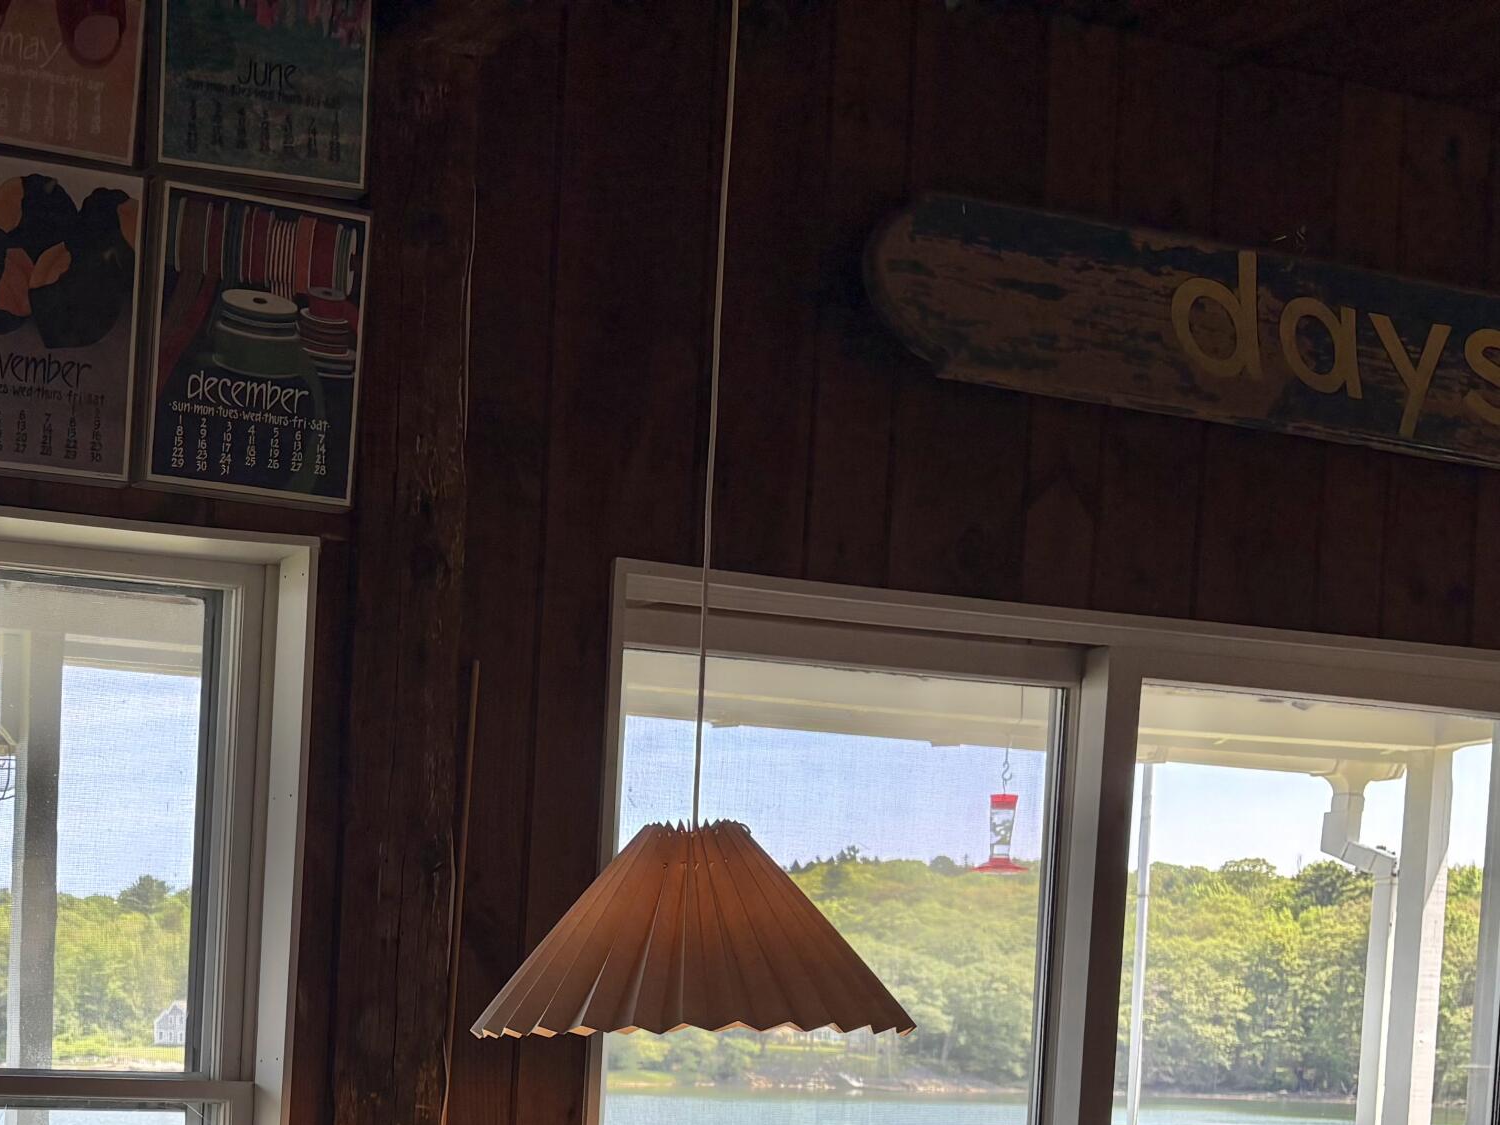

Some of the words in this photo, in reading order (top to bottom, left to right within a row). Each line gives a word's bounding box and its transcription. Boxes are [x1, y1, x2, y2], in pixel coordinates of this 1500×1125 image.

[0, 32, 62, 68] may
[188, 370, 309, 414] december
[176, 426, 183, 435] 8
[201, 429, 207, 438] 9
[223, 433, 232, 442] 10
[249, 436, 255, 444] 11
[271, 439, 279, 448] 12
[294, 442, 302, 451] 13
[317, 445, 326, 454] 14
[201, 418, 207, 428] 2
[227, 422, 232, 431] 3
[248, 425, 255, 434] 4
[274, 428, 279, 438] 5
[295, 431, 301, 440] 6
[319, 434, 325, 444] 7
[172, 448, 184, 457] 22
[197, 450, 208, 459] 23
[220, 454, 232, 463] 24
[246, 457, 256, 467] 25
[268, 460, 280, 469] 26
[291, 462, 302, 472] 27
[314, 466, 326, 475] 28
[175, 437, 183, 446] 15
[198, 440, 207, 449] 16
[222, 444, 231, 452] 17
[247, 446, 256, 456] 18
[270, 450, 279, 458] 19
[292, 452, 302, 461] 20
[317, 456, 325, 464] 21
[172, 458, 184, 468] 29
[197, 462, 207, 471] 30
[220, 465, 229, 475] 31
